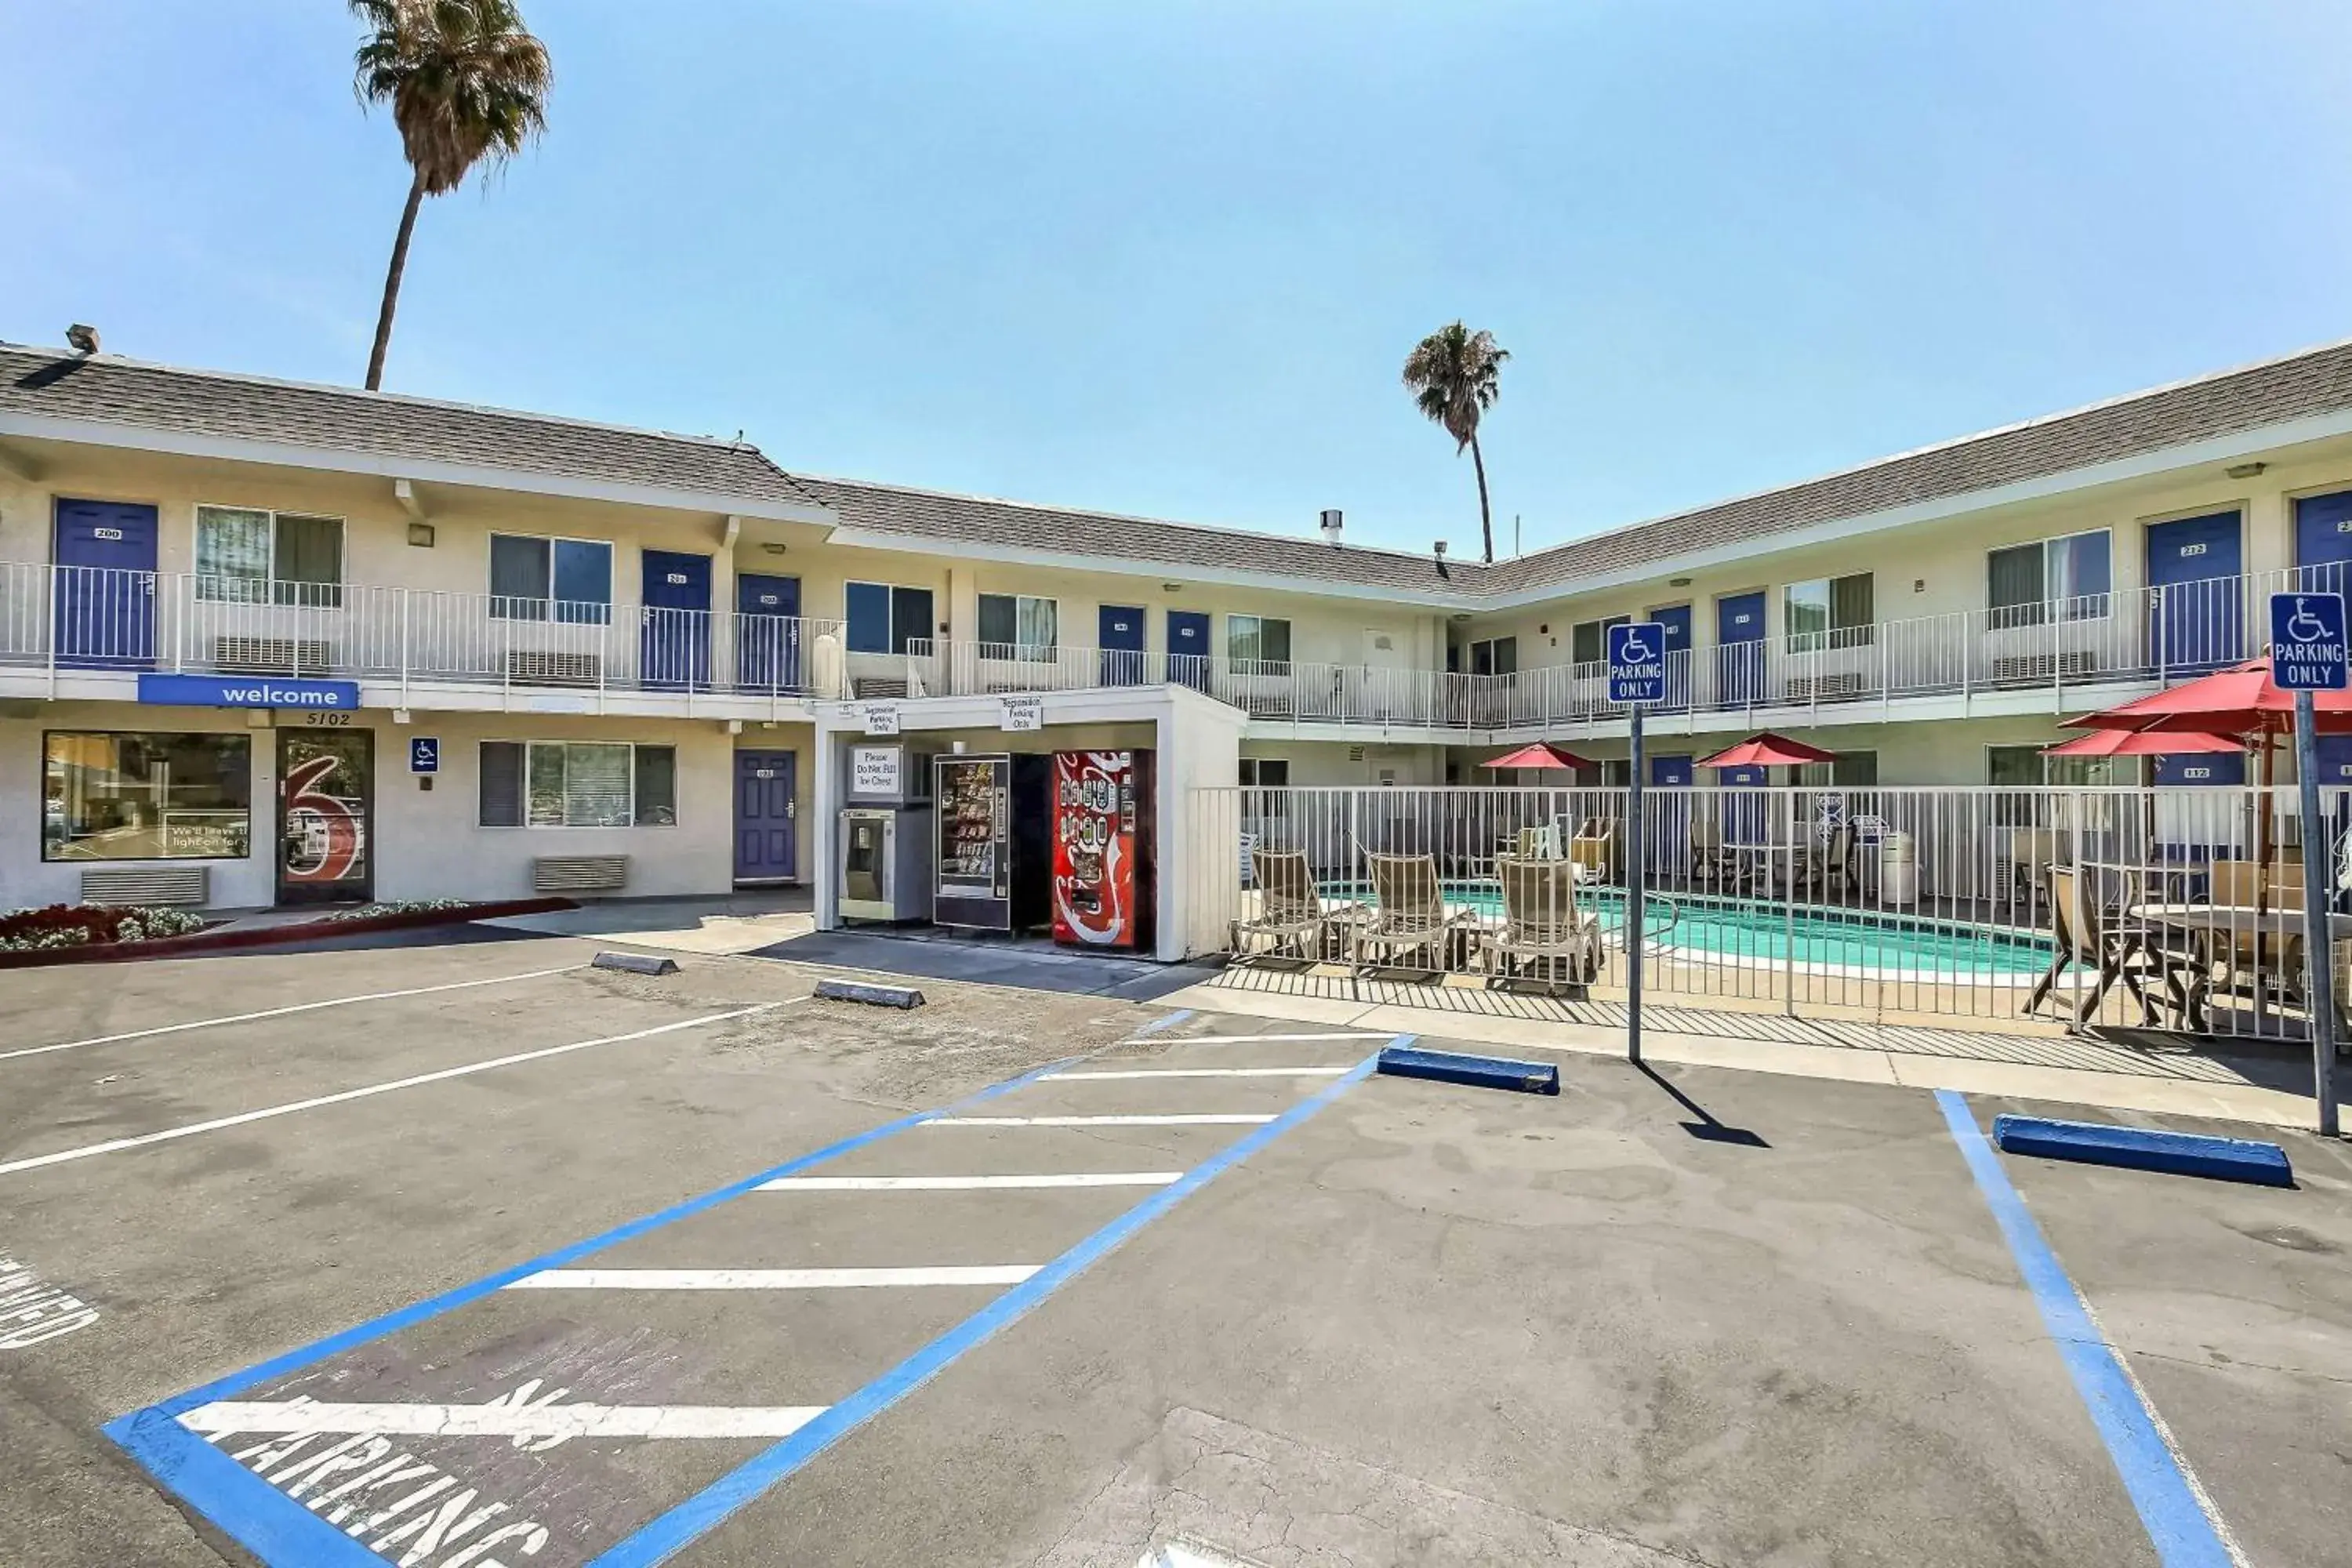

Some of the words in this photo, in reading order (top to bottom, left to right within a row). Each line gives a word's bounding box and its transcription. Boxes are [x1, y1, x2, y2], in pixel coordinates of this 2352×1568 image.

[96, 528, 120, 539] 200
[2183, 545, 2204, 554] 212
[2275, 644, 2343, 662] PARKING
[1611, 662, 1661, 680] PARKING
[2287, 665, 2332, 684] ONLY
[223, 684, 339, 705] welcome
[1619, 681, 1652, 697] ONLY
[307, 713, 350, 726] 5102
